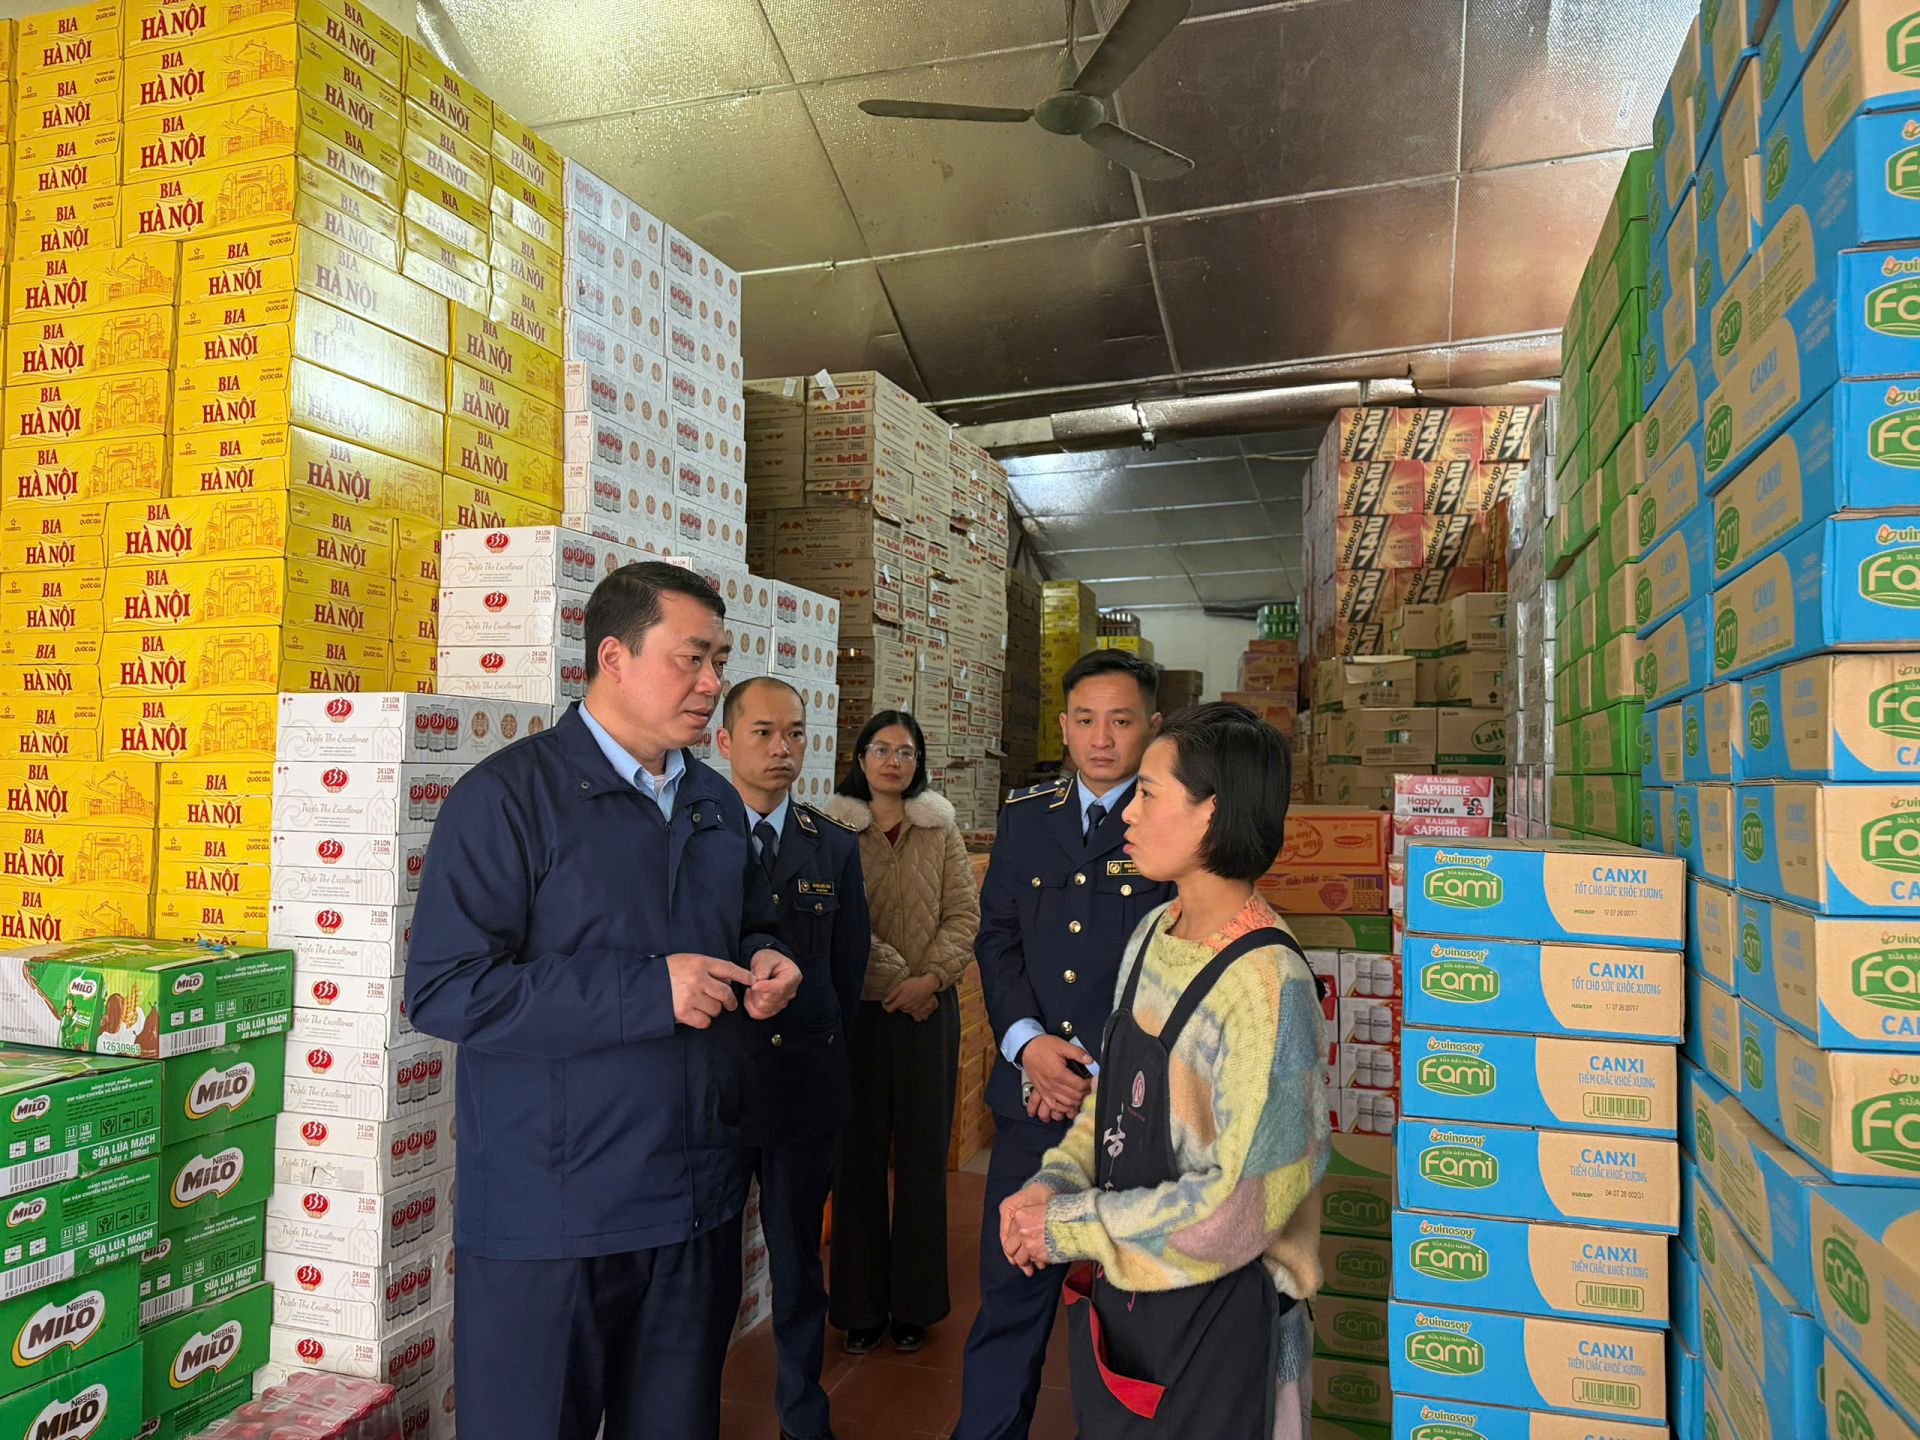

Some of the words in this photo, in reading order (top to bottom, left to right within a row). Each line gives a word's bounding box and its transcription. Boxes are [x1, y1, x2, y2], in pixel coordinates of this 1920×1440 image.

[344, 2, 364, 27] BIA
[58, 17, 78, 34] BIA
[326, 16, 348, 42] HÀ
[350, 35, 376, 66] NỘI
[43, 39, 63, 66] HÀ
[62, 38, 92, 63] NỘI
[162, 52, 184, 69] BIA
[140, 69, 167, 105] HÀ
[169, 68, 205, 101] NỘI
[444, 74, 460, 97] BIA
[430, 90, 446, 114] HÀ
[448, 108, 470, 132] NỘI
[160, 180, 182, 198] BIA
[138, 201, 166, 234] HÀ
[168, 198, 204, 232] NỘI
[228, 242, 249, 258] BIA
[208, 270, 230, 296] HÀ
[230, 267, 262, 294] NỘI
[43, 323, 64, 340] BIA
[482, 320, 498, 338] BIA
[22, 344, 48, 373] HÀ
[50, 341, 84, 374] NỘI
[468, 333, 486, 360] HÀ
[489, 351, 512, 374] NỘI
[835, 401, 849, 410] Red
[42, 519, 62, 534] BIA
[332, 513, 352, 532] BIA
[26, 543, 46, 564] HÀ
[46, 541, 75, 567] NỘI
[317, 538, 338, 559] HÀ
[340, 546, 366, 569] NỘI
[146, 570, 168, 586] BIA
[124, 590, 151, 619] HÀ
[153, 589, 190, 623] NỘI
[206, 775, 227, 790] BIA
[1414, 784, 1471, 795] SAPPHIRE
[1408, 797, 1442, 806] Happy
[188, 800, 211, 823] HÀ
[213, 801, 242, 829] NỘI
[24, 828, 44, 844] BIA
[1413, 825, 1469, 836] SAPPHIRE
[4, 850, 30, 876] HÀ
[30, 849, 64, 882] NỘI
[1592, 867, 1647, 884] CANXI
[1588, 885, 1602, 895] CHO
[1589, 962, 1644, 980] CANXI
[71, 982, 93, 994] MILO
[176, 978, 200, 989] MILO
[1586, 980, 1600, 990] CHO
[102, 1041, 140, 1055] 12630969
[1590, 1056, 1644, 1073] CANXI
[197, 1078, 248, 1104] MILO
[17, 1101, 46, 1116] MILO
[92, 1144, 110, 1160] SỮA
[1581, 1149, 1636, 1167] CANXI
[182, 1164, 236, 1193] MILO
[12, 1203, 42, 1222] MILO
[88, 1241, 108, 1260] SỮA
[1583, 1244, 1638, 1263] CANXI
[28, 1308, 96, 1349] MILO
[180, 1336, 235, 1372] MILO
[1578, 1341, 1634, 1360] CANXI
